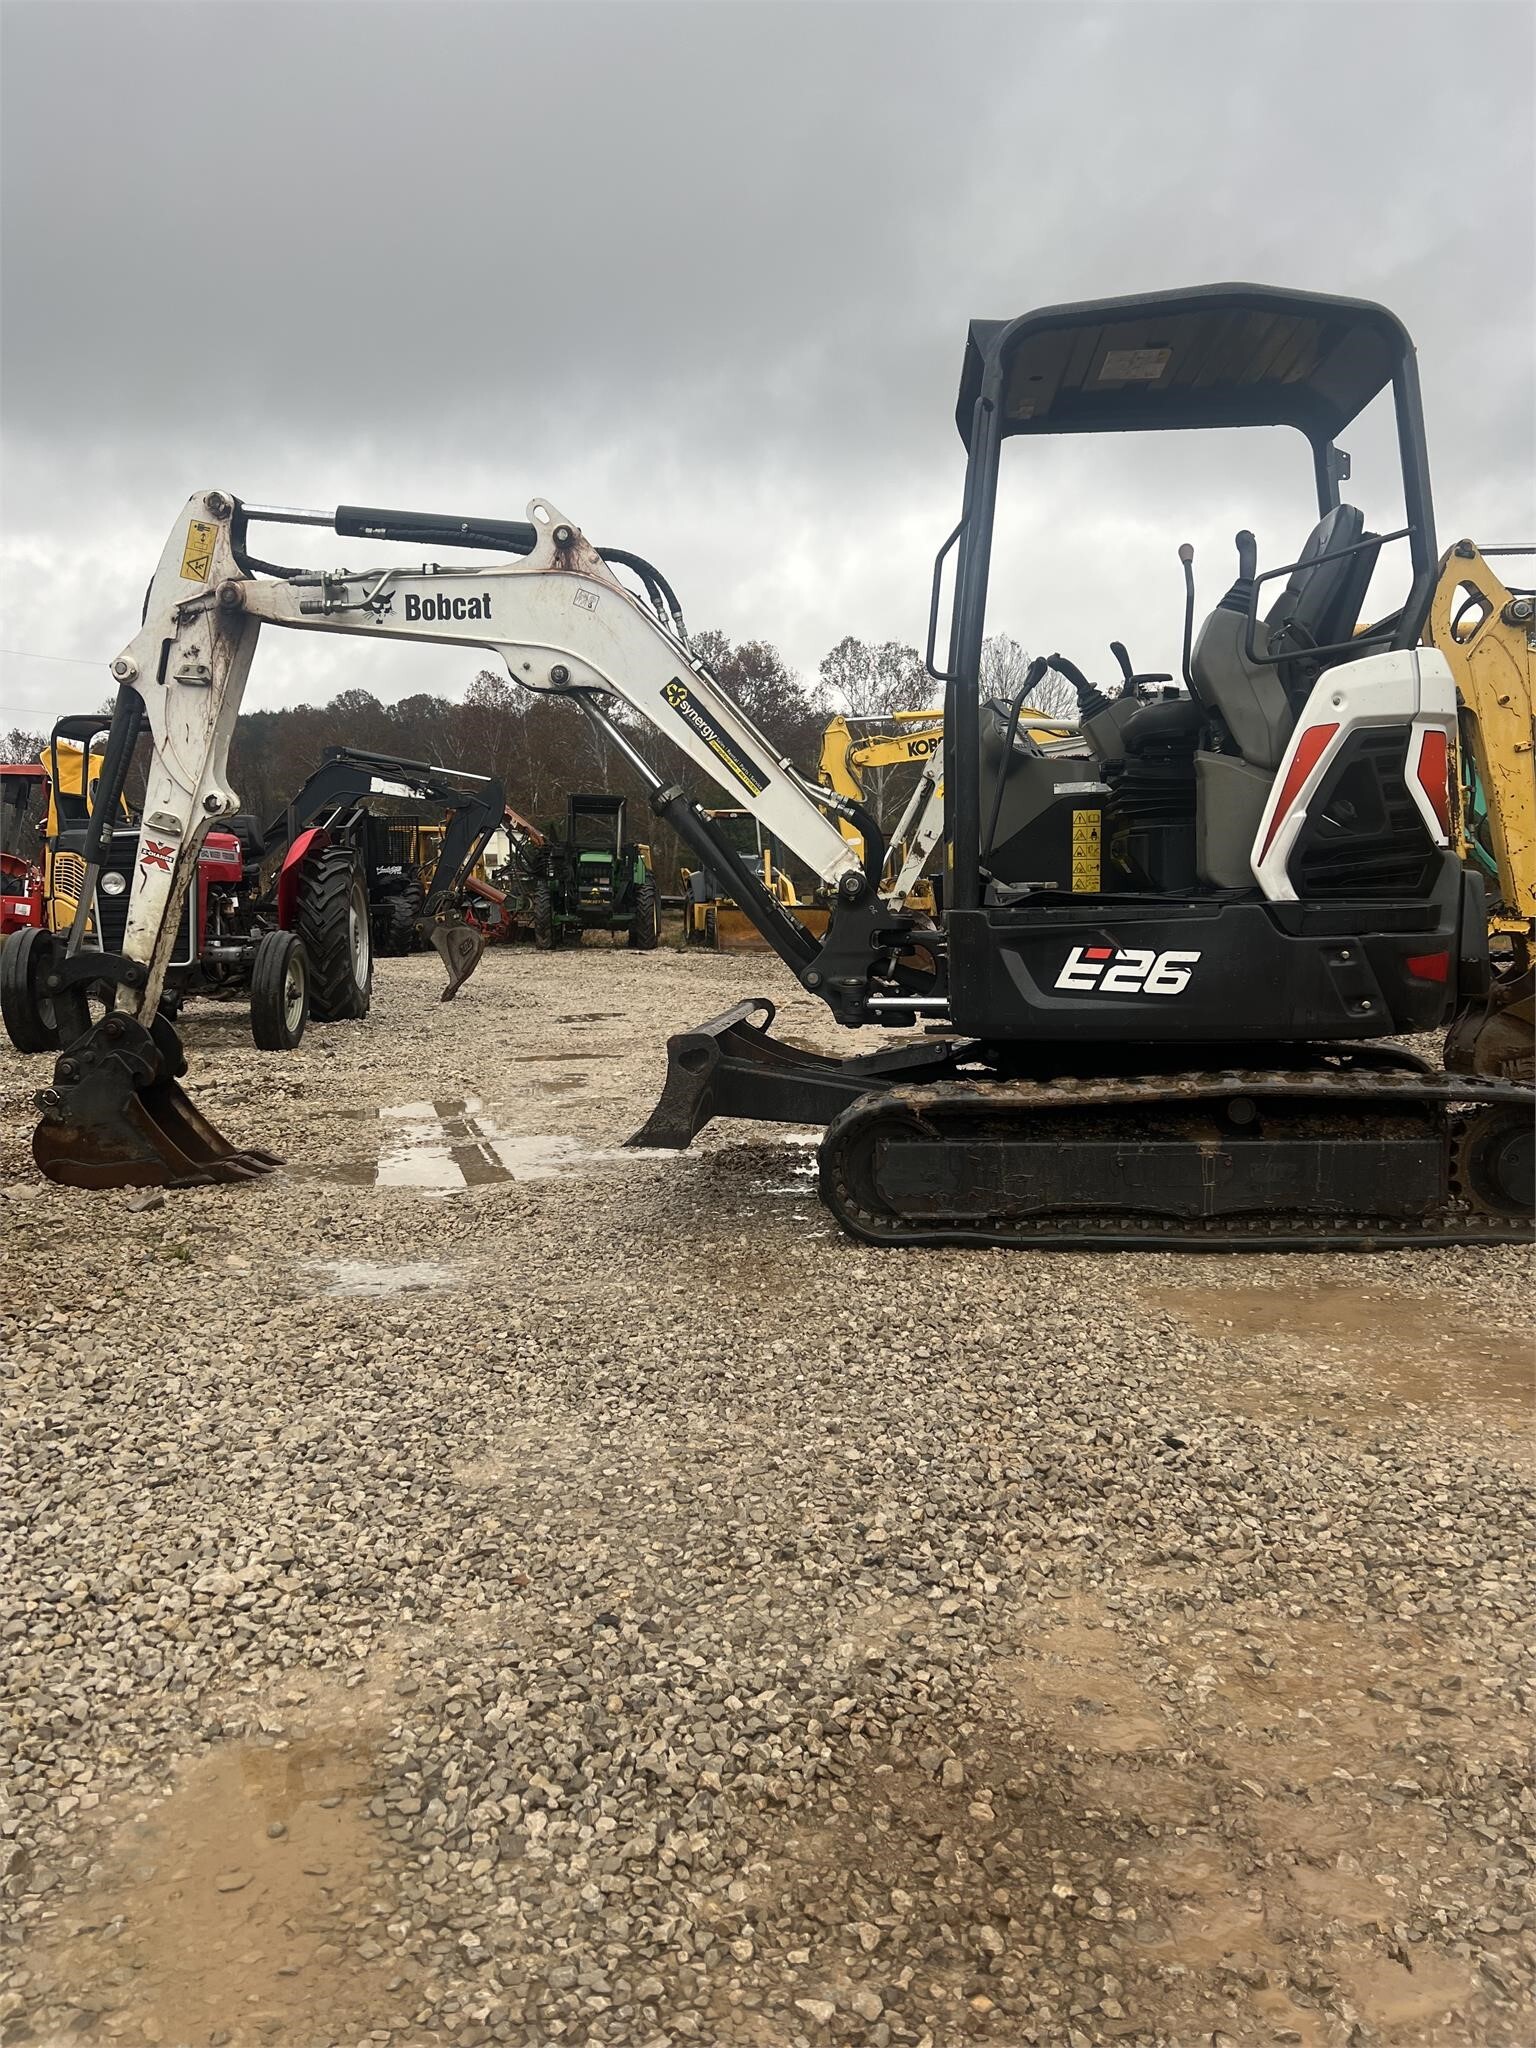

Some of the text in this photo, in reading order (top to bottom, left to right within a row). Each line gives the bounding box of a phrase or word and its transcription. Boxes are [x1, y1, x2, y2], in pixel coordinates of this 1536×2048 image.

[404, 592, 492, 621] Bobcat
[679, 700, 717, 741] synergy
[726, 749, 739, 763] Rental
[739, 763, 750, 775] Parts
[749, 775, 764, 790] Service
[1054, 947, 1201, 994] E26
